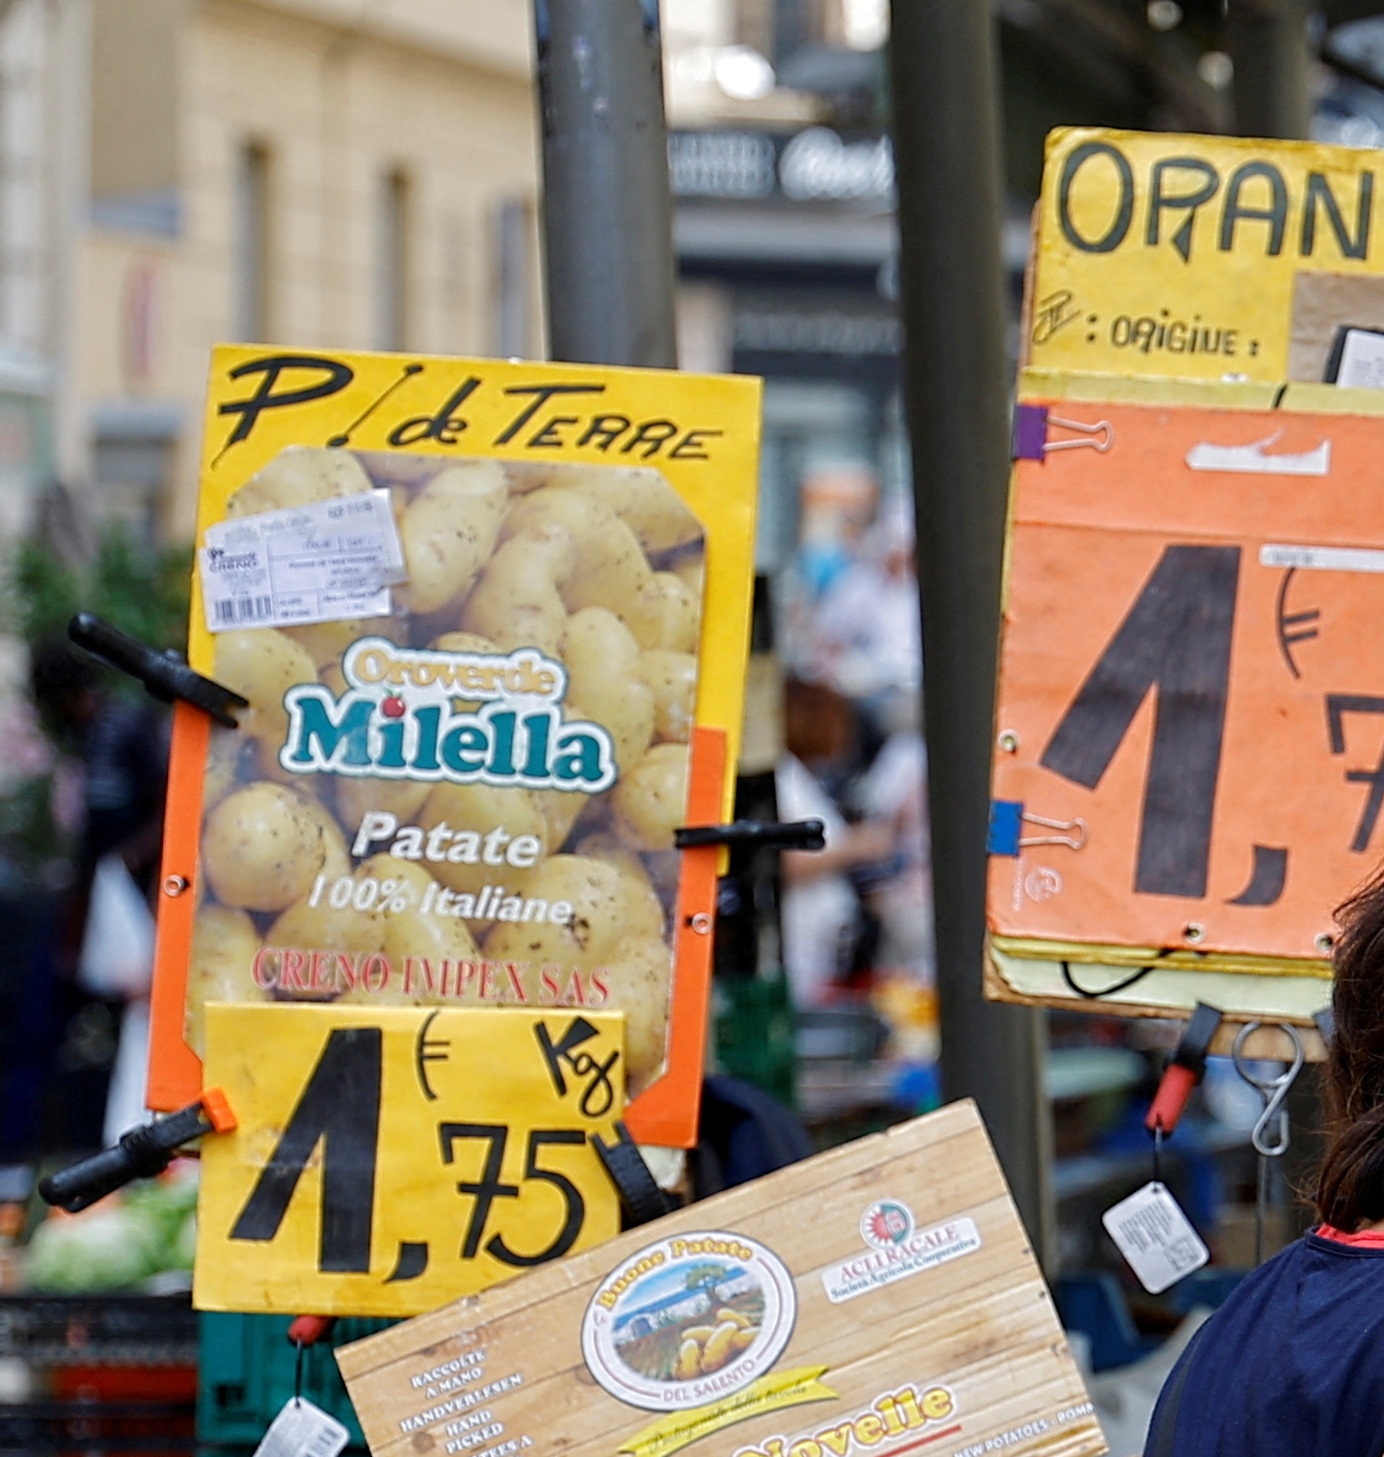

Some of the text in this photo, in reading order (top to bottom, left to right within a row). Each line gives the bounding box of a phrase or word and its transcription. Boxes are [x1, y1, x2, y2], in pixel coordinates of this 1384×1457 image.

[389, 376, 481, 449] de
[494, 385, 724, 461] TERRE
[355, 649, 557, 697] Oroverde
[293, 695, 604, 783] Milella
[351, 811, 542, 868] Patate
[310, 874, 572, 926] 100% Italiane
[251, 946, 611, 1004] CRENO IMPEX SAS
[597, 1237, 753, 1310] Buone Patate
[410, 1350, 486, 1389] RACCOLTE
[425, 1367, 484, 1399] A MANO
[663, 1360, 756, 1402] DEL SALENTO
[400, 1373, 523, 1433] HANDVERLESEN
[445, 1410, 492, 1436] HAND
[445, 1422, 504, 1455] PICKED
[521, 1434, 534, 1448] A
[984, 1418, 1050, 1452] POTATOES
